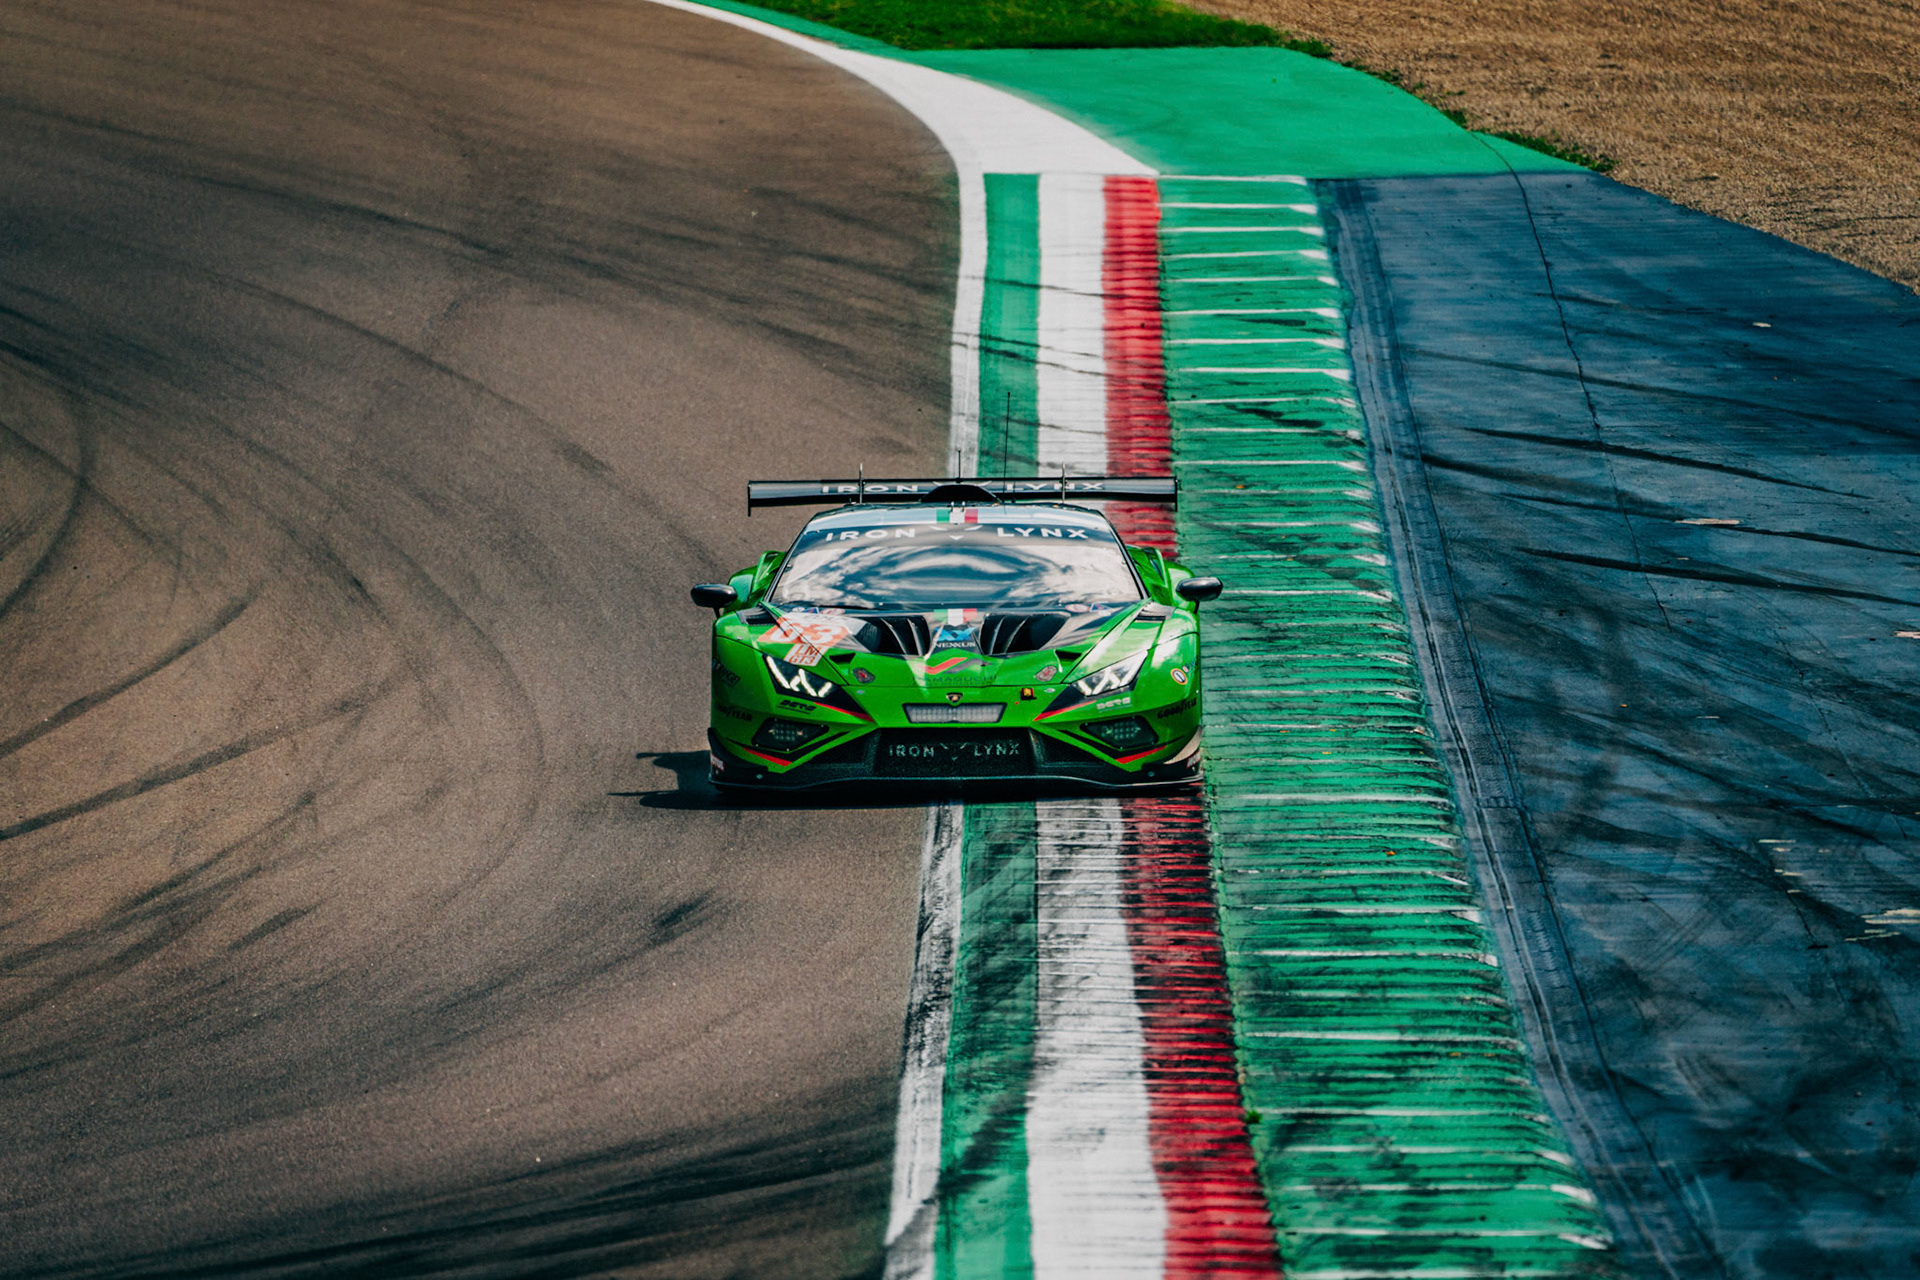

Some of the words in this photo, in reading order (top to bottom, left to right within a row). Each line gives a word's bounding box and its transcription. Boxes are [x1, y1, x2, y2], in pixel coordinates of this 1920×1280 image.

[822, 485, 919, 493] IRON
[826, 529, 916, 541] IRON
[997, 528, 1089, 539] LYNX
[769, 622, 839, 644] 63
[797, 645, 822, 656] LM
[789, 655, 816, 665] GT3
[889, 744, 935, 757] IRON
[974, 741, 1020, 756] LYNX
